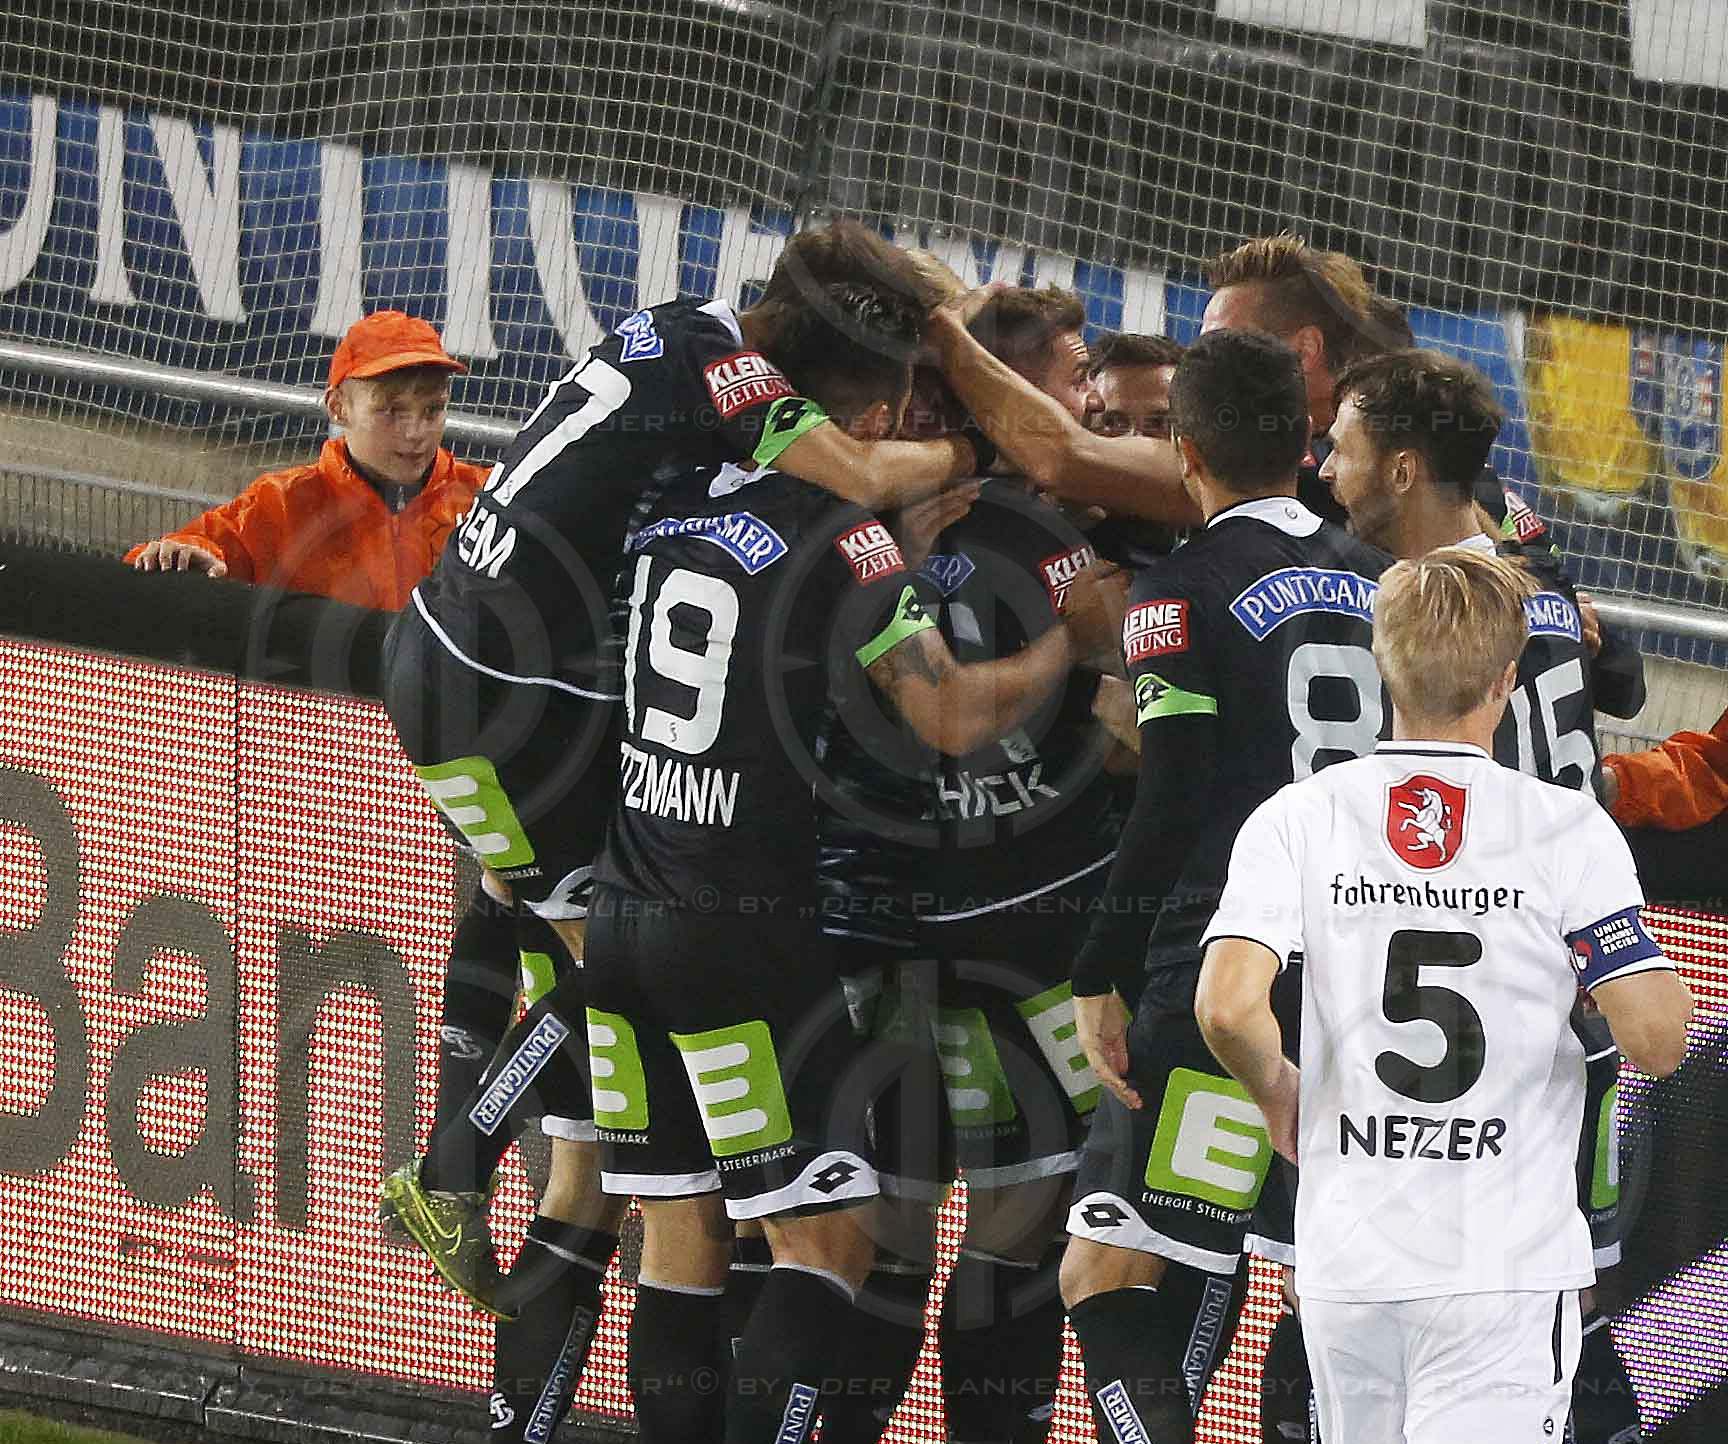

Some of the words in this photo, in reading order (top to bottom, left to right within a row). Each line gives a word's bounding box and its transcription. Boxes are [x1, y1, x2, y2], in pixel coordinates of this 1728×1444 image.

[840, 524, 894, 558] KLEI
[1241, 574, 1375, 628] PUNTIGAM
[624, 554, 740, 754] 19
[1592, 916, 1632, 939] UNITE
[1374, 929, 1487, 1104] 5
[1339, 1113, 1507, 1161] NETZER
